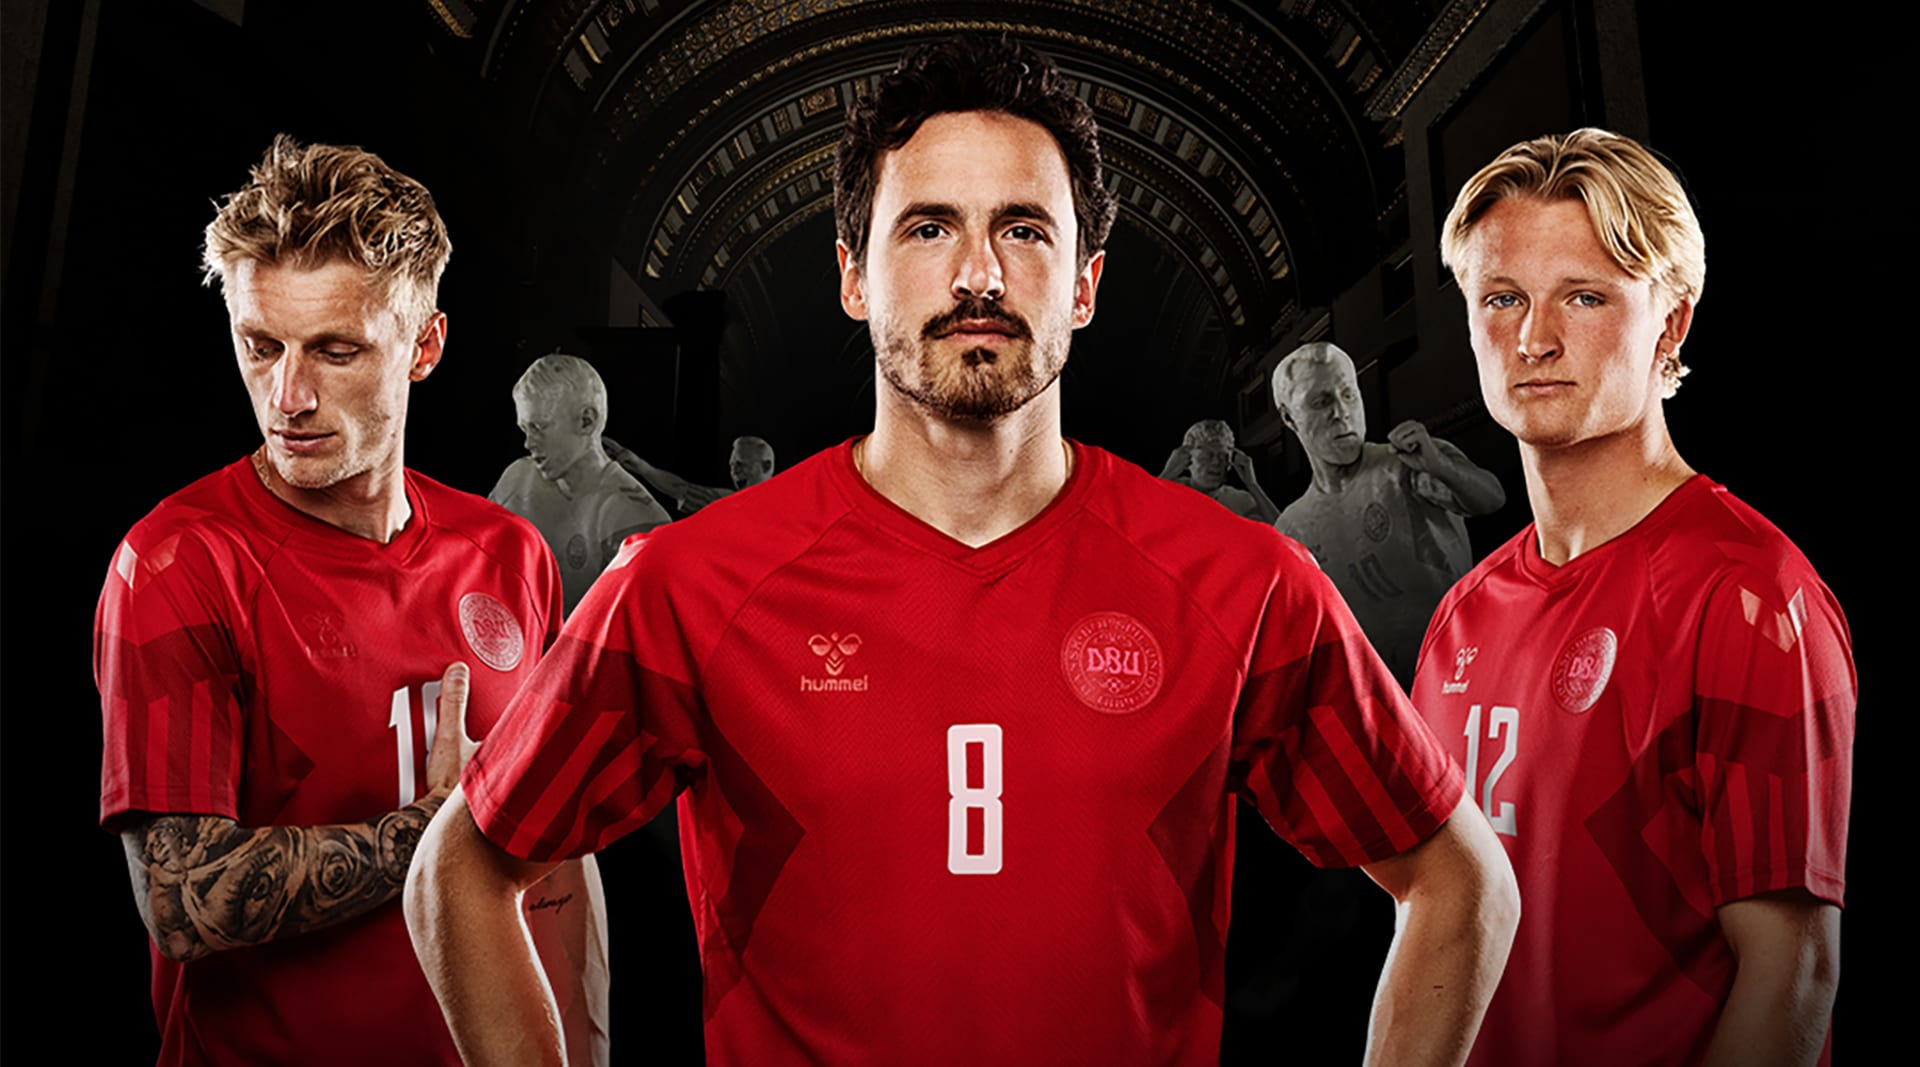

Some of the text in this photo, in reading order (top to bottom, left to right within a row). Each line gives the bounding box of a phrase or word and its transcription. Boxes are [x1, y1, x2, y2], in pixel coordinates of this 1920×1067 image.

[800, 674, 869, 692] hummel
[1087, 646, 1142, 676] DBU
[947, 724, 1003, 875] 8
[1463, 704, 1520, 836] 12
